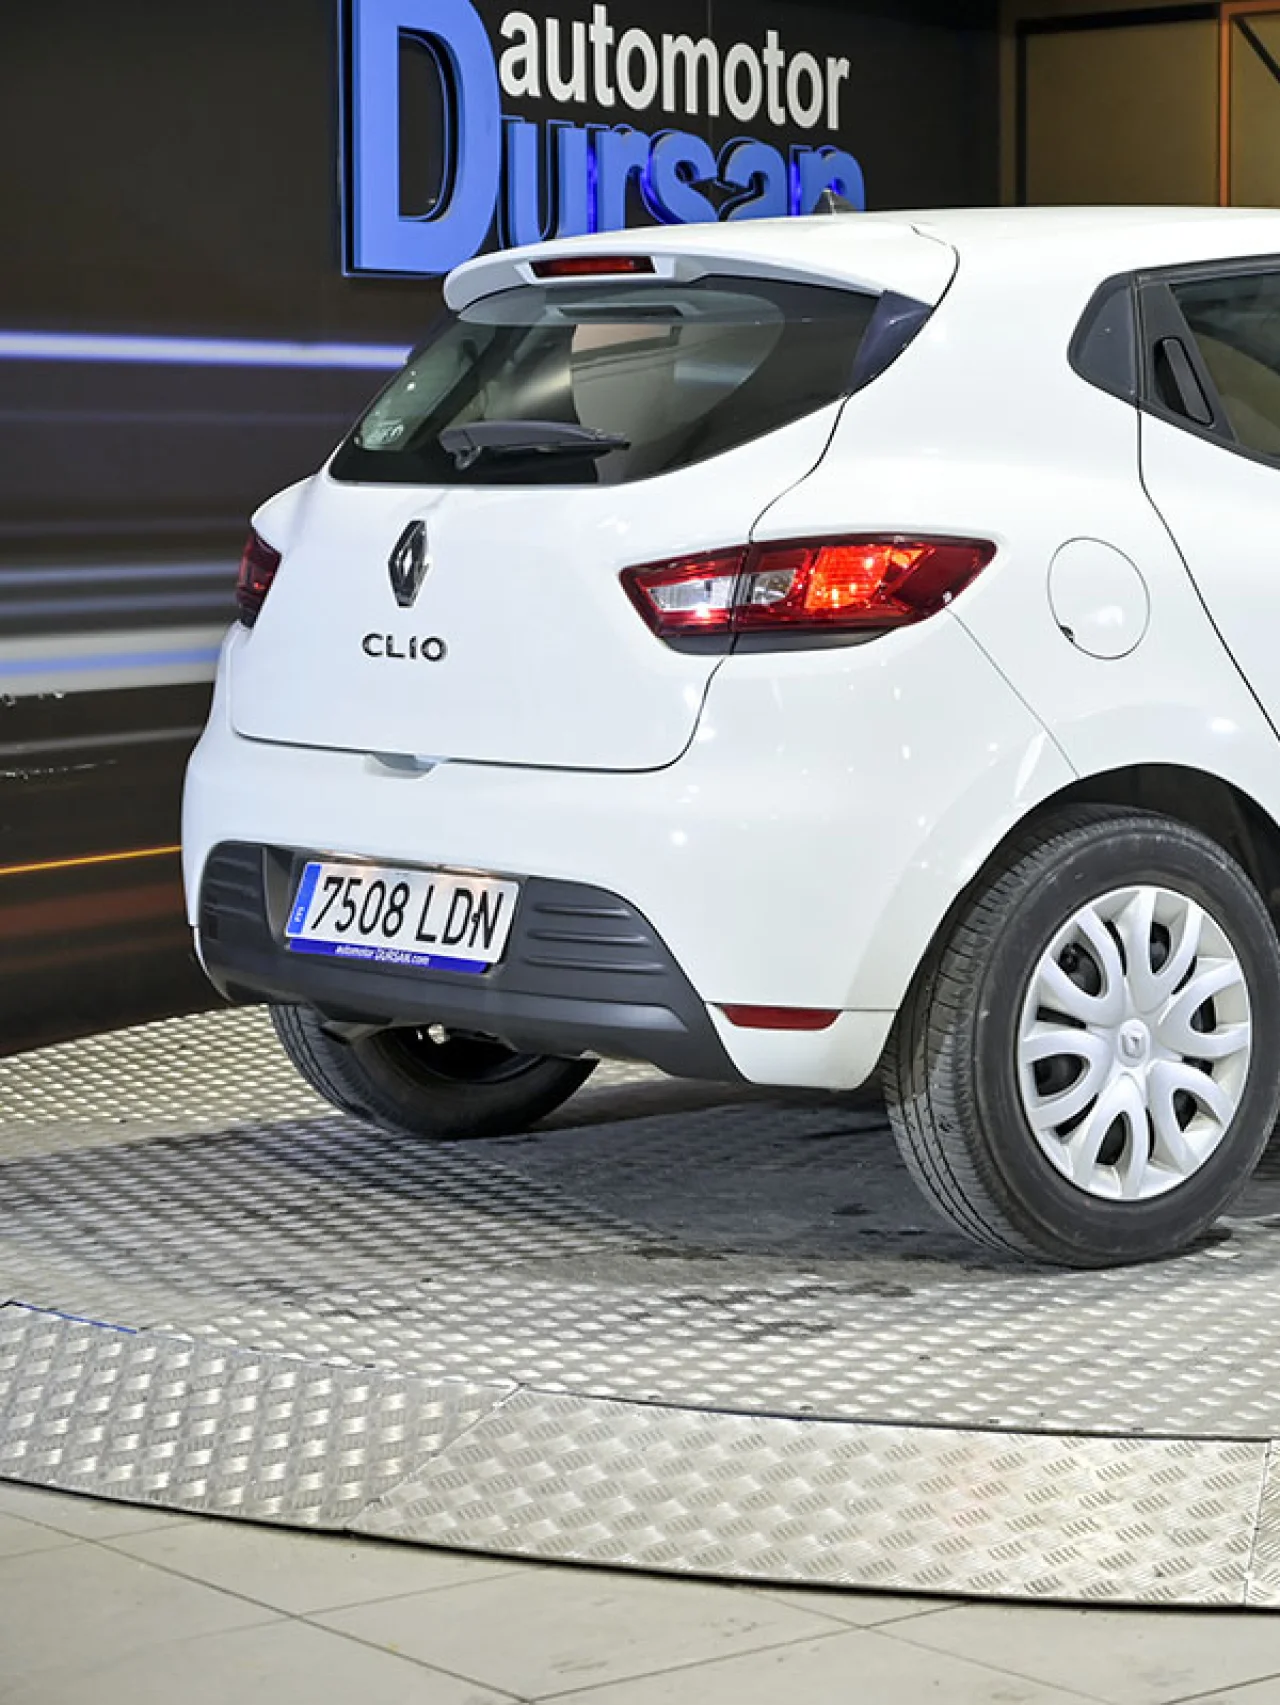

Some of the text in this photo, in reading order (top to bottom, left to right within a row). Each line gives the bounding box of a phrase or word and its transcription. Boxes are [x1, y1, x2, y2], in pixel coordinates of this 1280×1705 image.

[499, 3, 850, 130] automotor
[362, 632, 447, 662] CLIO
[311, 876, 504, 950] 7508 LDN
